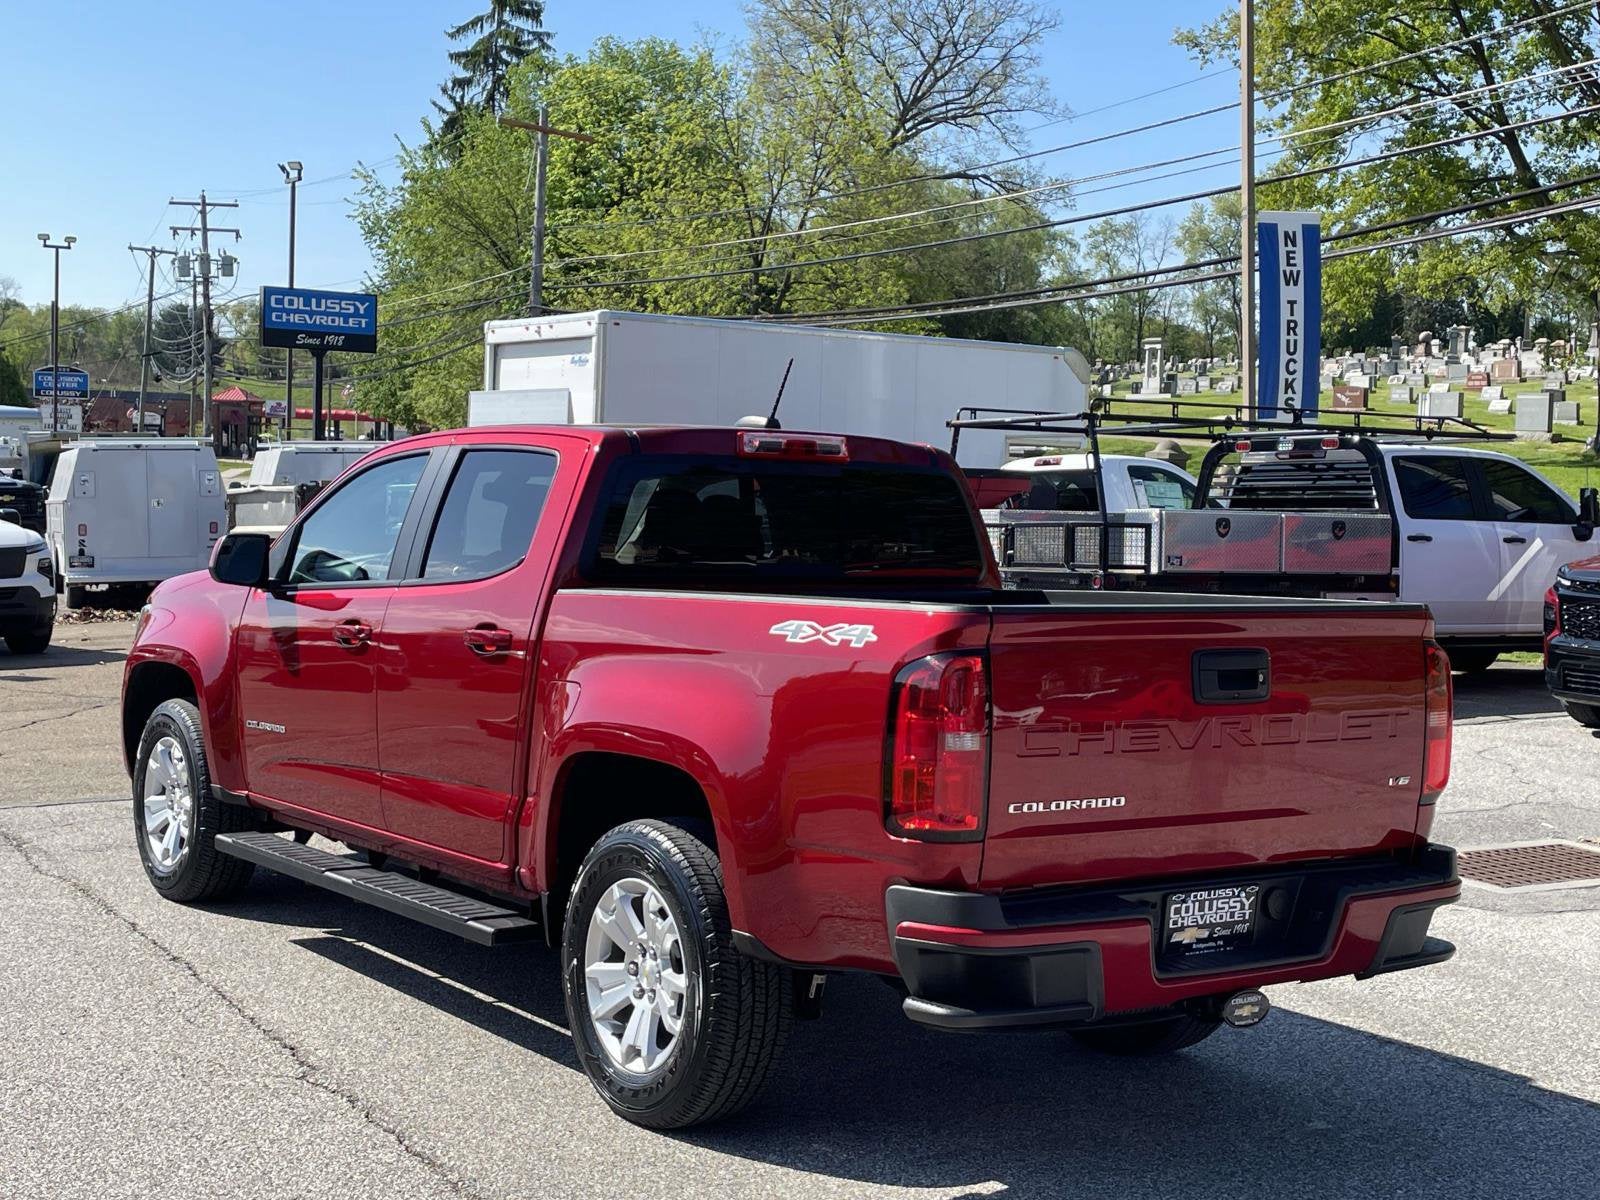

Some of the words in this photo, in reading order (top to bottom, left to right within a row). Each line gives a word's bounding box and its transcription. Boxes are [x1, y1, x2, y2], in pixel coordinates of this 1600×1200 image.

[1282, 230, 1301, 287] NEW
[270, 294, 370, 315] COLUSSY
[271, 312, 369, 328] CHEVROLET
[295, 333, 321, 345] Since
[323, 334, 346, 346] 1918
[1283, 299, 1298, 415] TRUCKS
[38, 375, 84, 383] COLISION
[1015, 708, 1410, 758] CHEVROLET
[1387, 775, 1411, 787] V6
[1007, 796, 1126, 815] COLORADO
[1190, 887, 1242, 901] COLUSSY
[1169, 896, 1255, 919] COLUSSY
[1168, 909, 1253, 929] CHEVROLET
[1232, 922, 1250, 935] 1918
